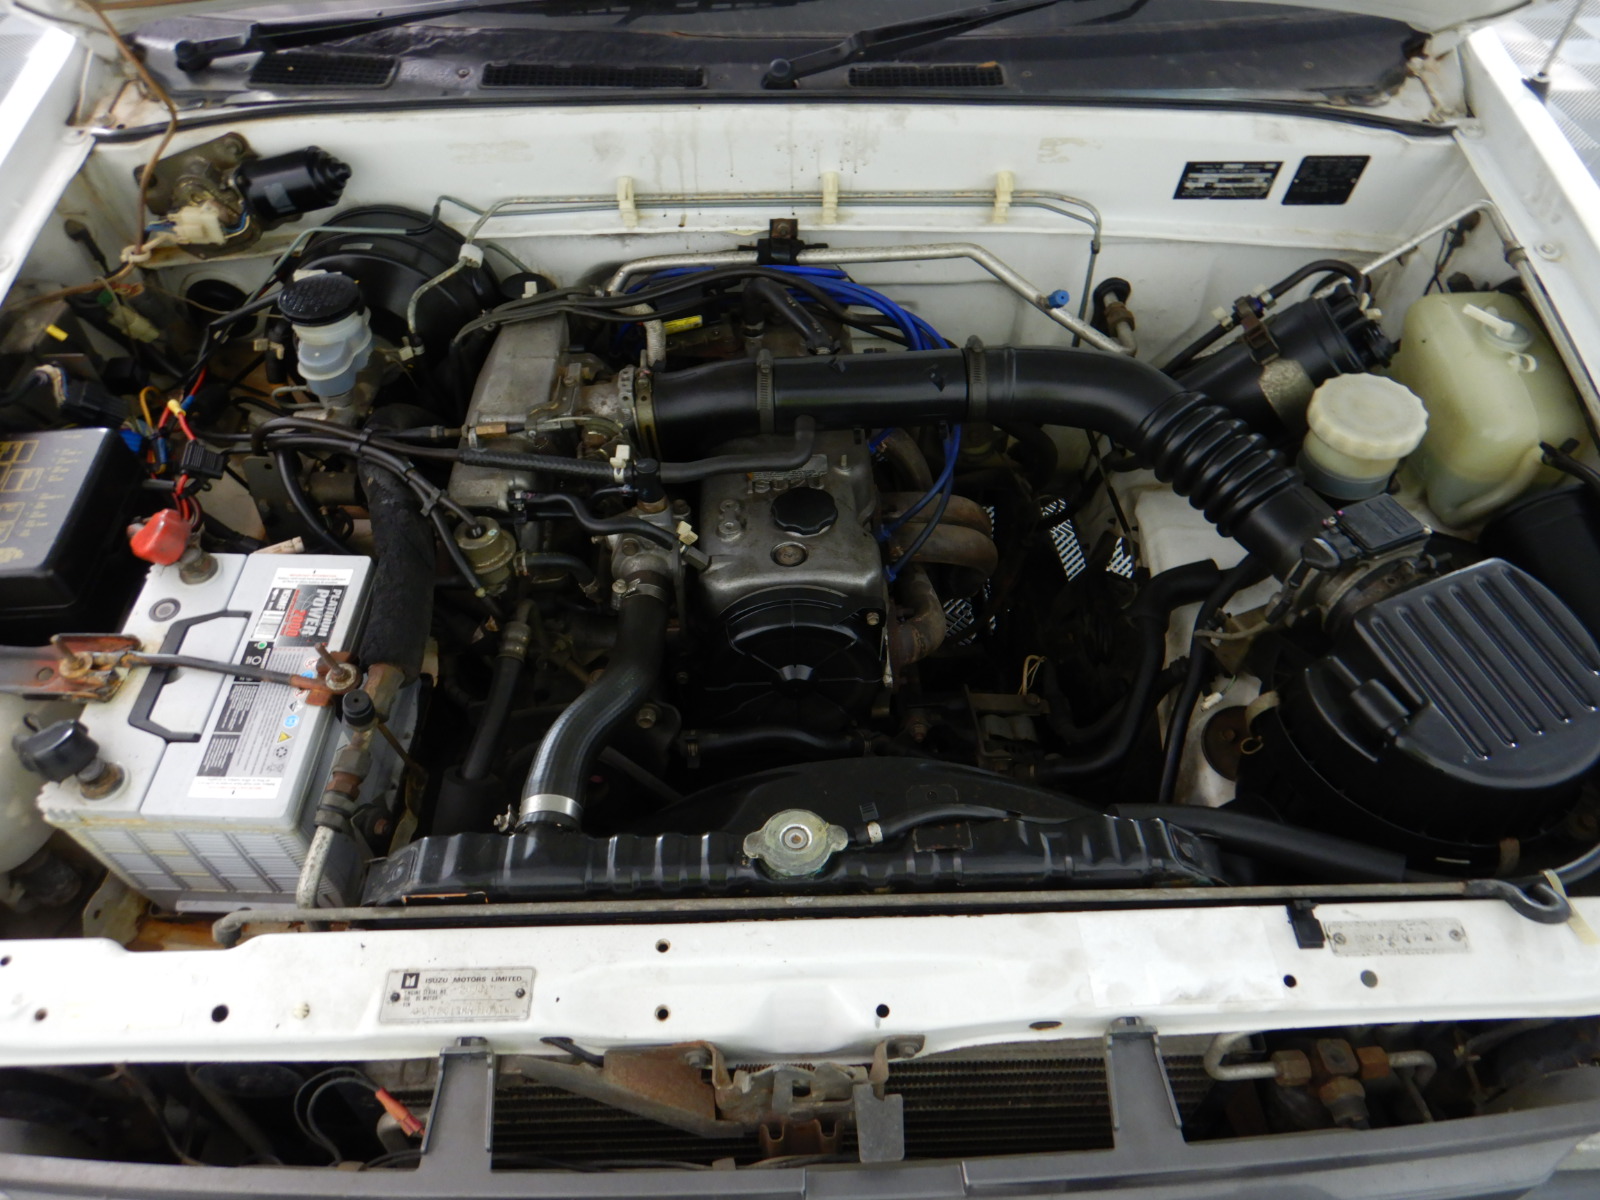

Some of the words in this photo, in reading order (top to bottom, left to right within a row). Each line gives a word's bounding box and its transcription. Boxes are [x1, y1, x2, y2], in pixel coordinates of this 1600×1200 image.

[285, 609, 308, 637] 2000
[301, 588, 330, 636] POWER
[317, 588, 343, 637] PLATINUM
[452, 976, 487, 984] MOTORS
